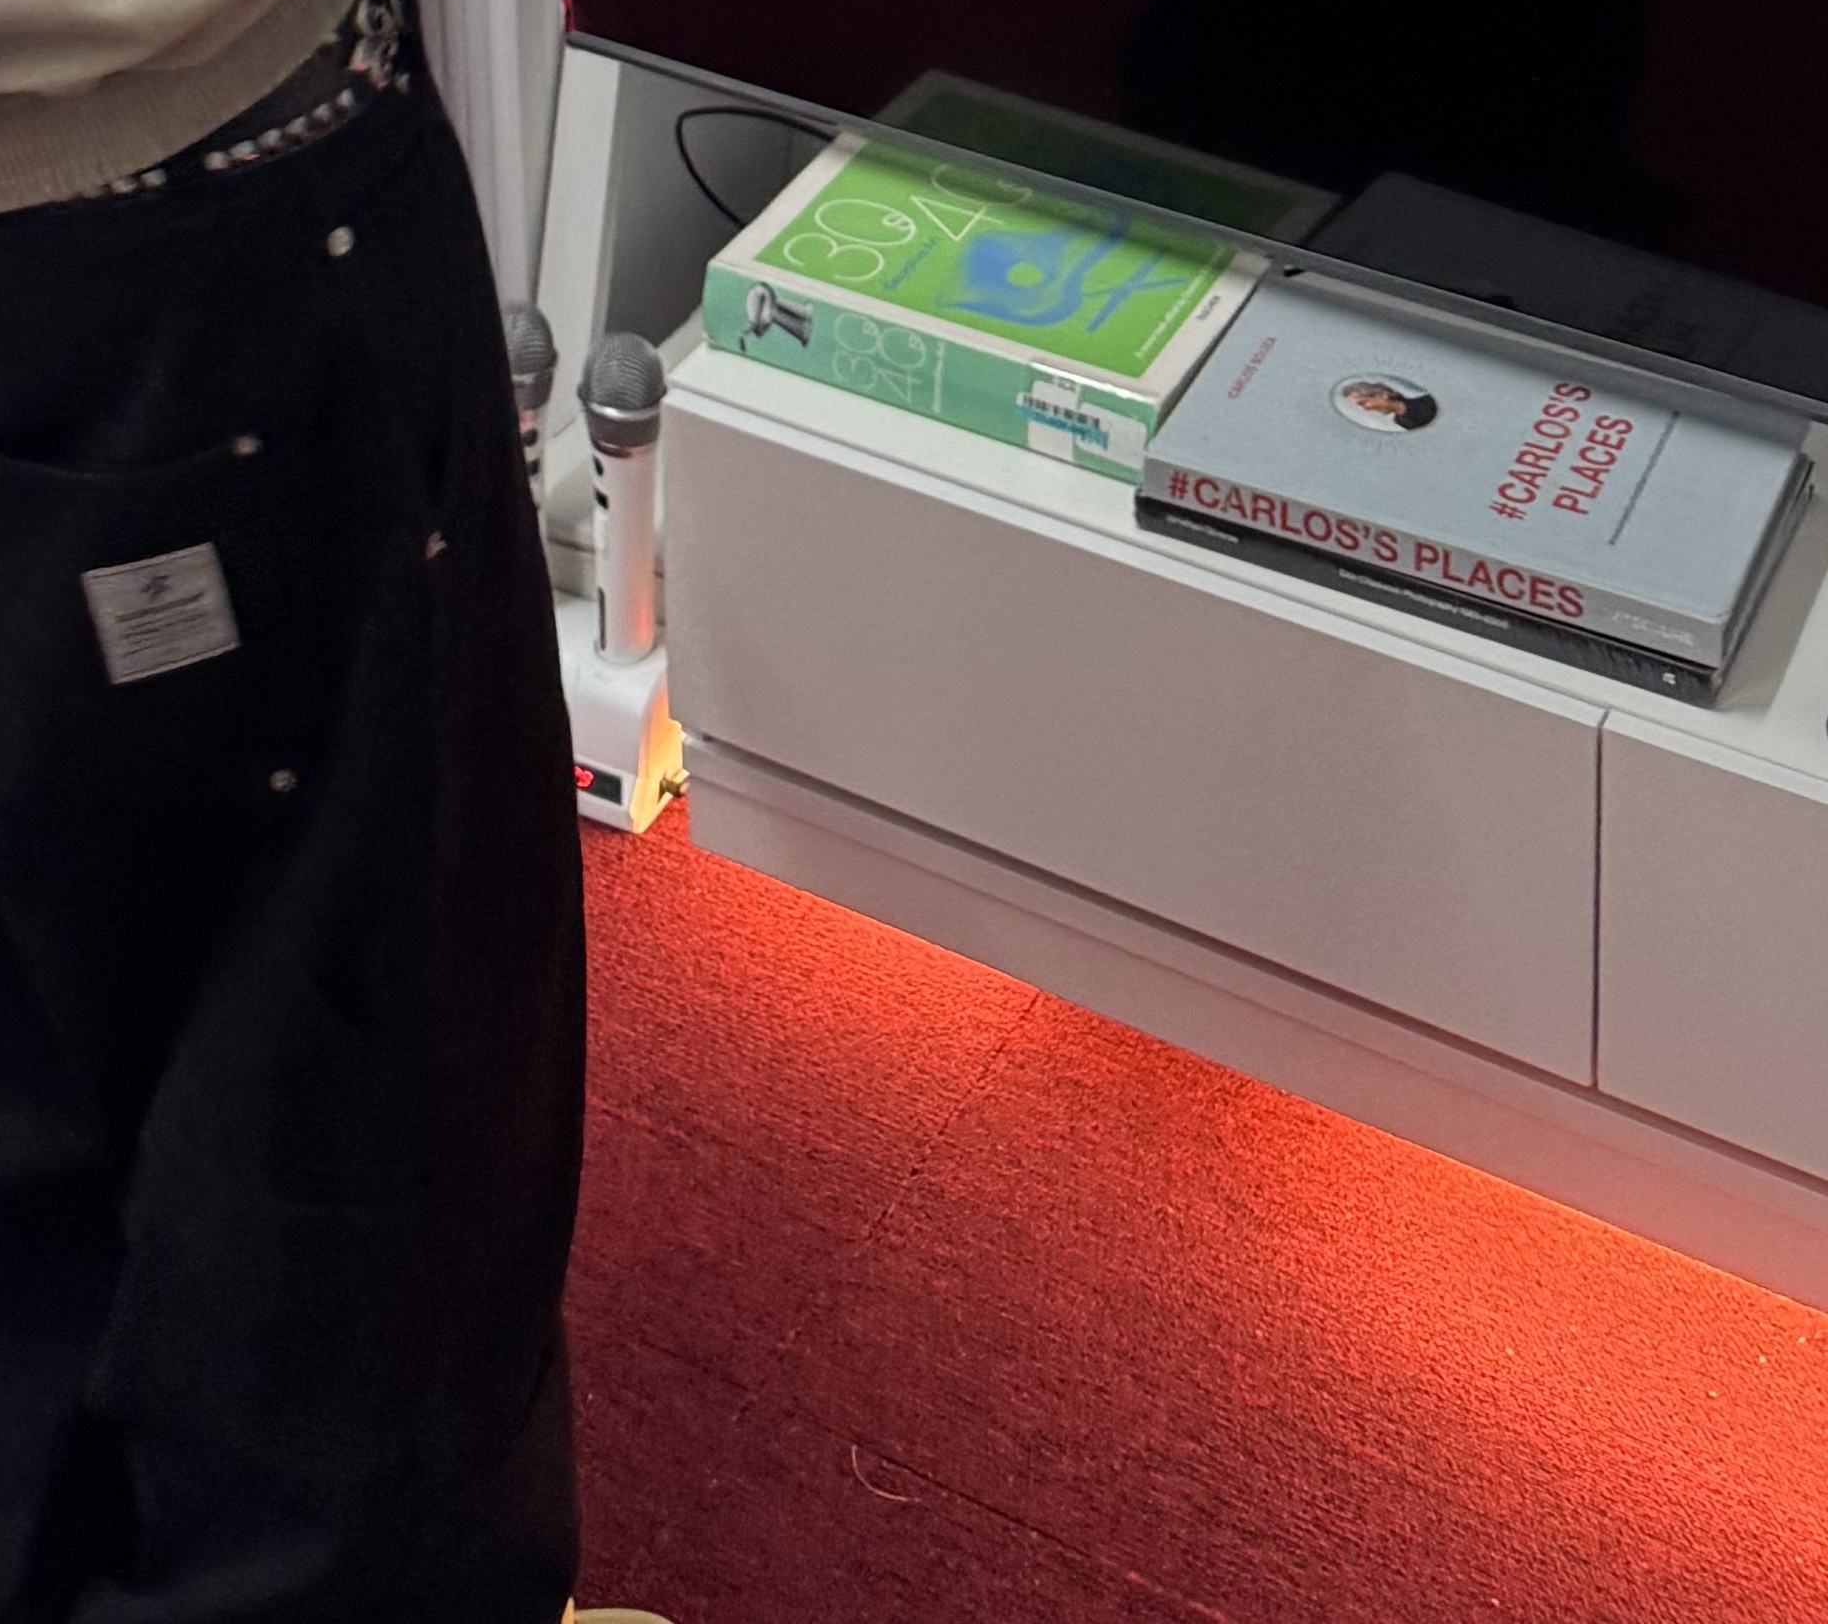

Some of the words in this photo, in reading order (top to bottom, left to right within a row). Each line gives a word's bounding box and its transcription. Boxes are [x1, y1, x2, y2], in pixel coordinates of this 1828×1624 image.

[1489, 382, 1591, 520] #CARLOS'S
[1552, 415, 1634, 515] PLACES
[1168, 471, 1399, 563] #CARLOS'S
[1414, 542, 1584, 618] PLACES
